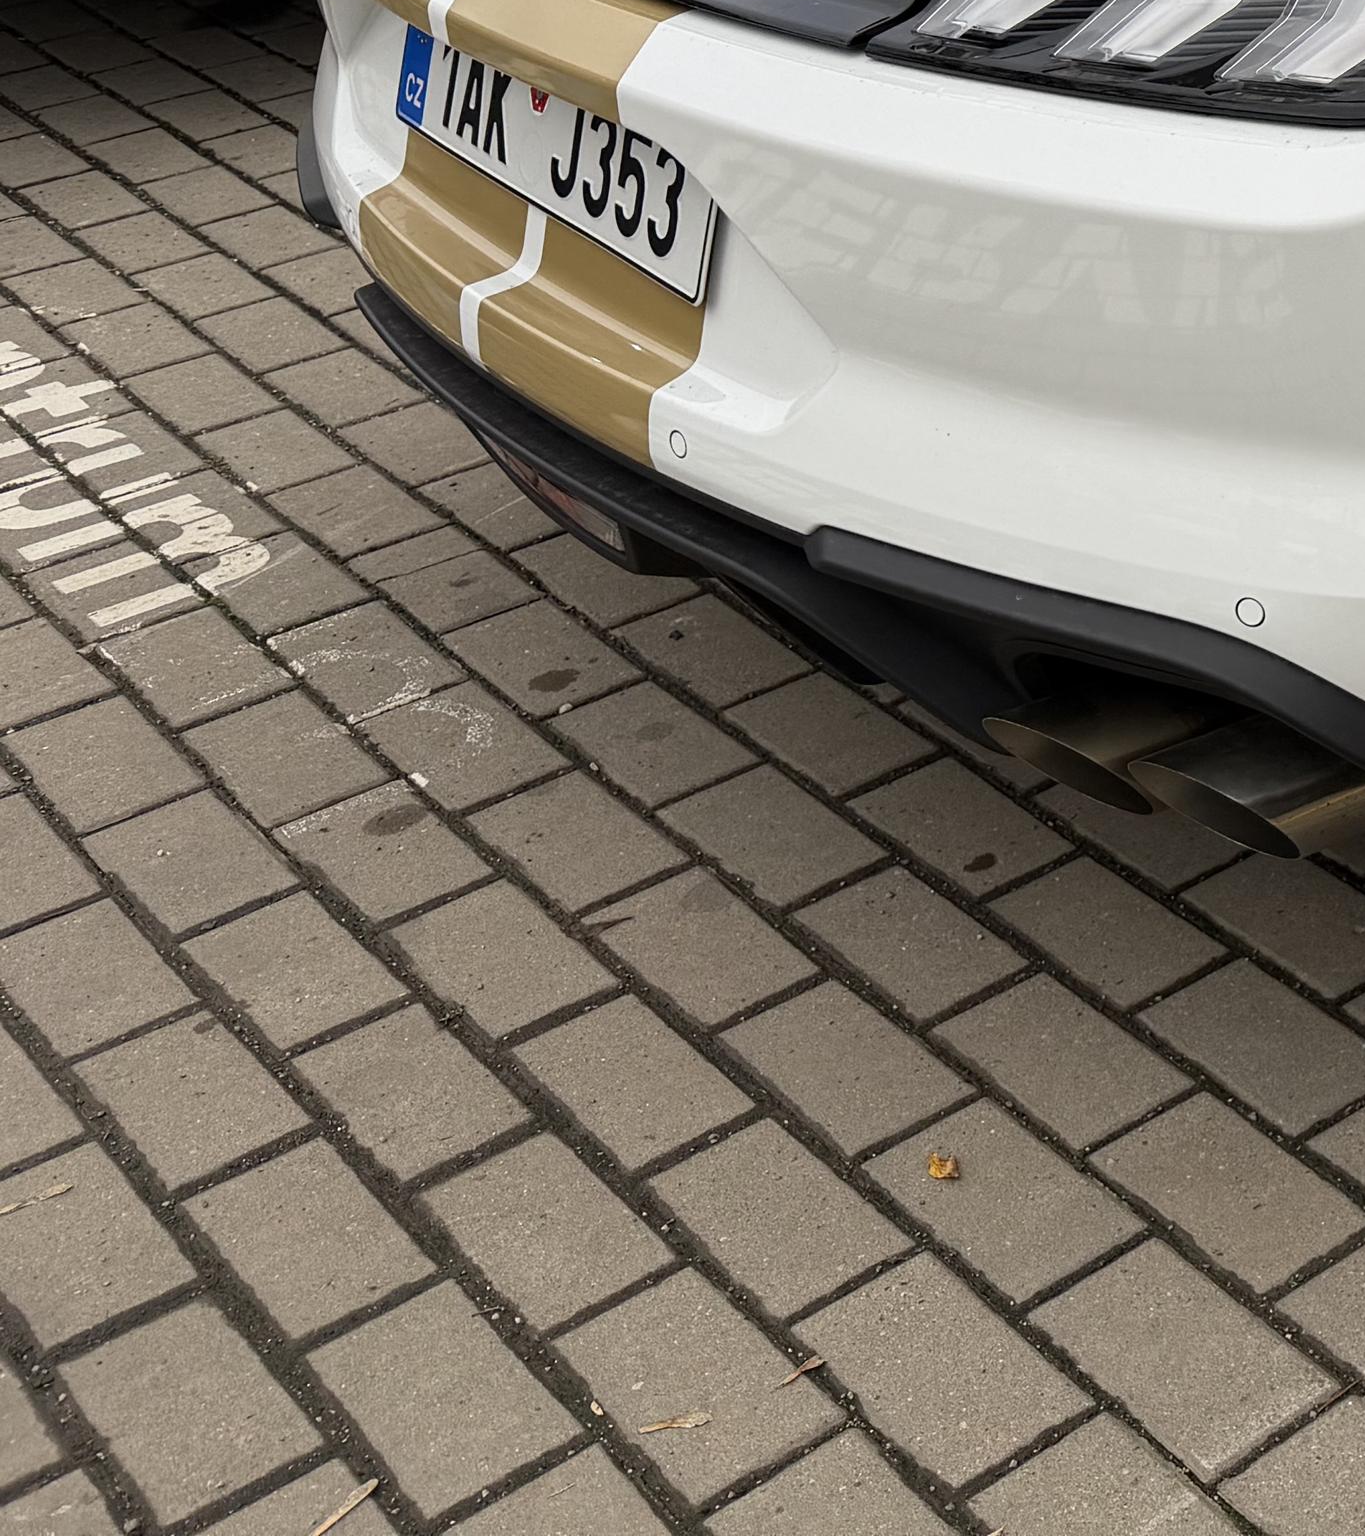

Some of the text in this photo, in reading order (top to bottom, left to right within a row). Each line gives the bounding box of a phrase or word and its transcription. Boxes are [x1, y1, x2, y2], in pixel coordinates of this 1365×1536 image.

[404, 72, 426, 110] CZ
[441, 44, 687, 258] 1AK J353
